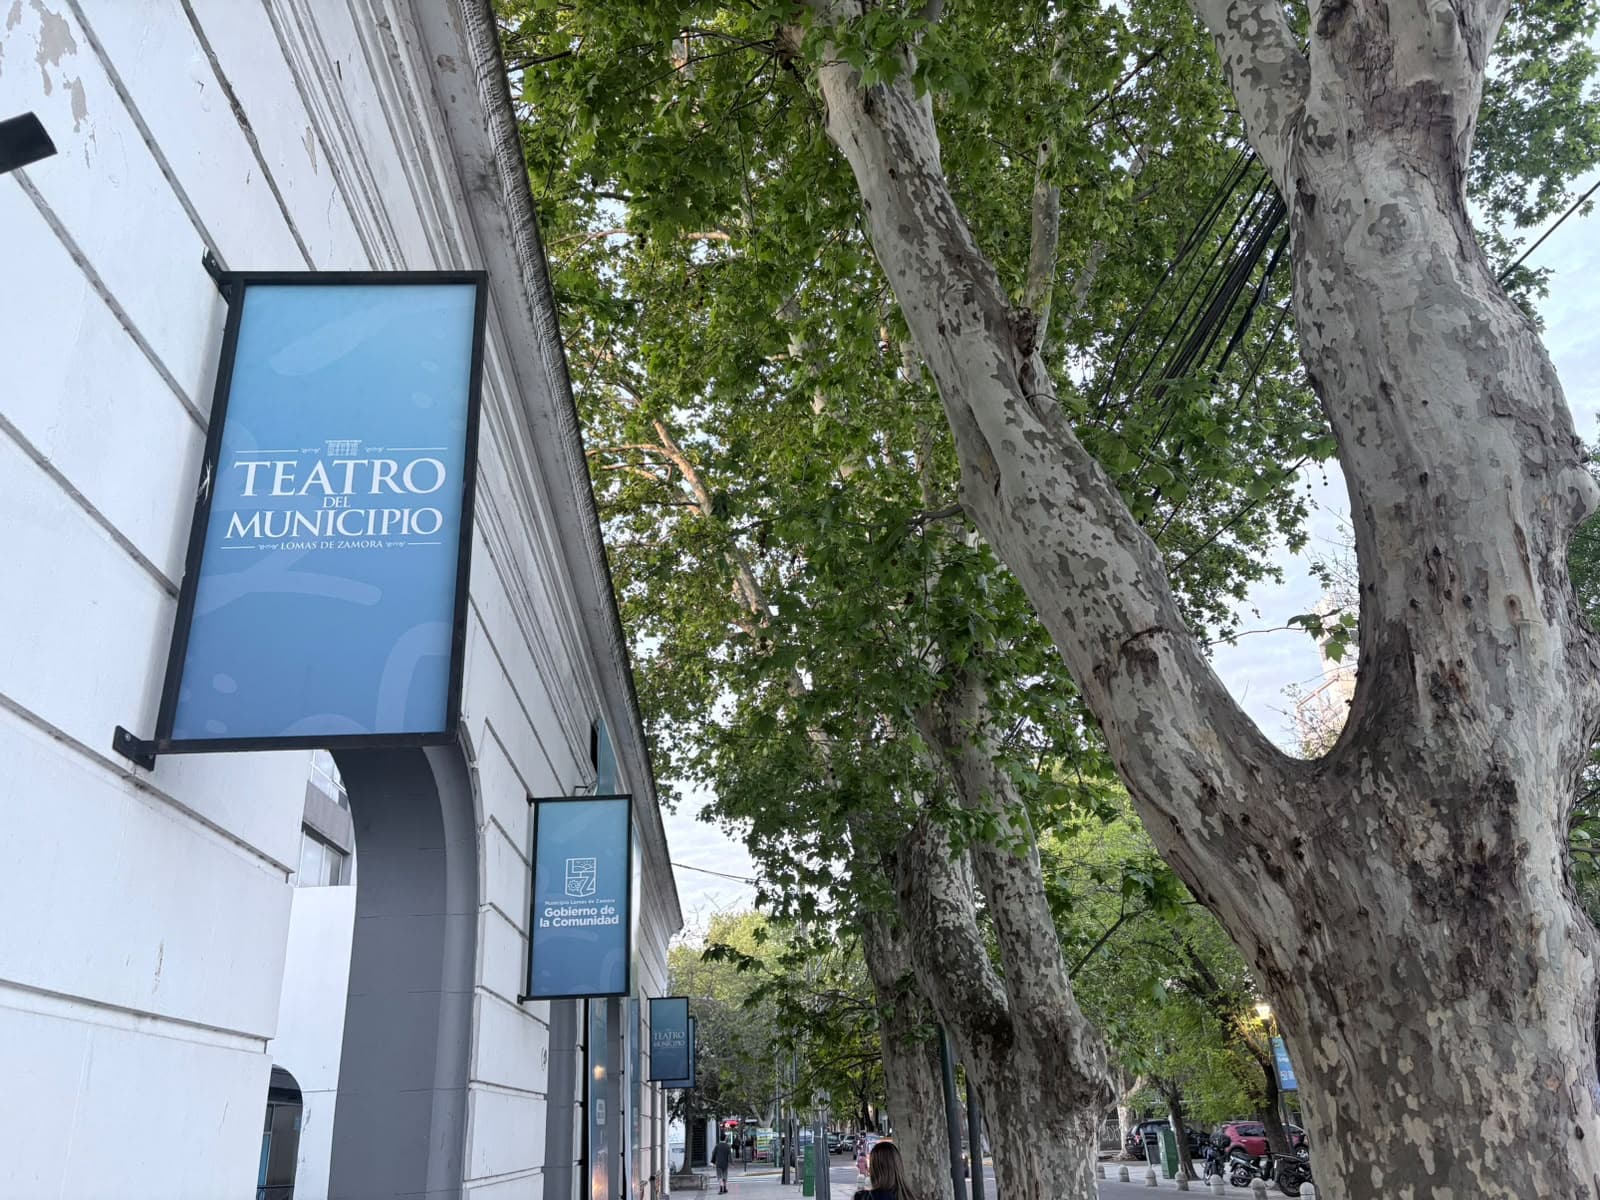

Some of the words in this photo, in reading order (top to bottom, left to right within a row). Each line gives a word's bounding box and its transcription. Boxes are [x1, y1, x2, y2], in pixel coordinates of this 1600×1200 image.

[233, 458, 446, 497] TEATRO
[323, 496, 351, 508] DEL
[224, 507, 443, 539] MUNICIPIO
[281, 541, 317, 550] LOMAS
[320, 541, 335, 549] DE
[337, 540, 383, 549] ZAMORA
[544, 906, 598, 917] Gobierno
[600, 905, 615, 915] de
[539, 917, 550, 928] la
[552, 914, 619, 927] Comunidad
